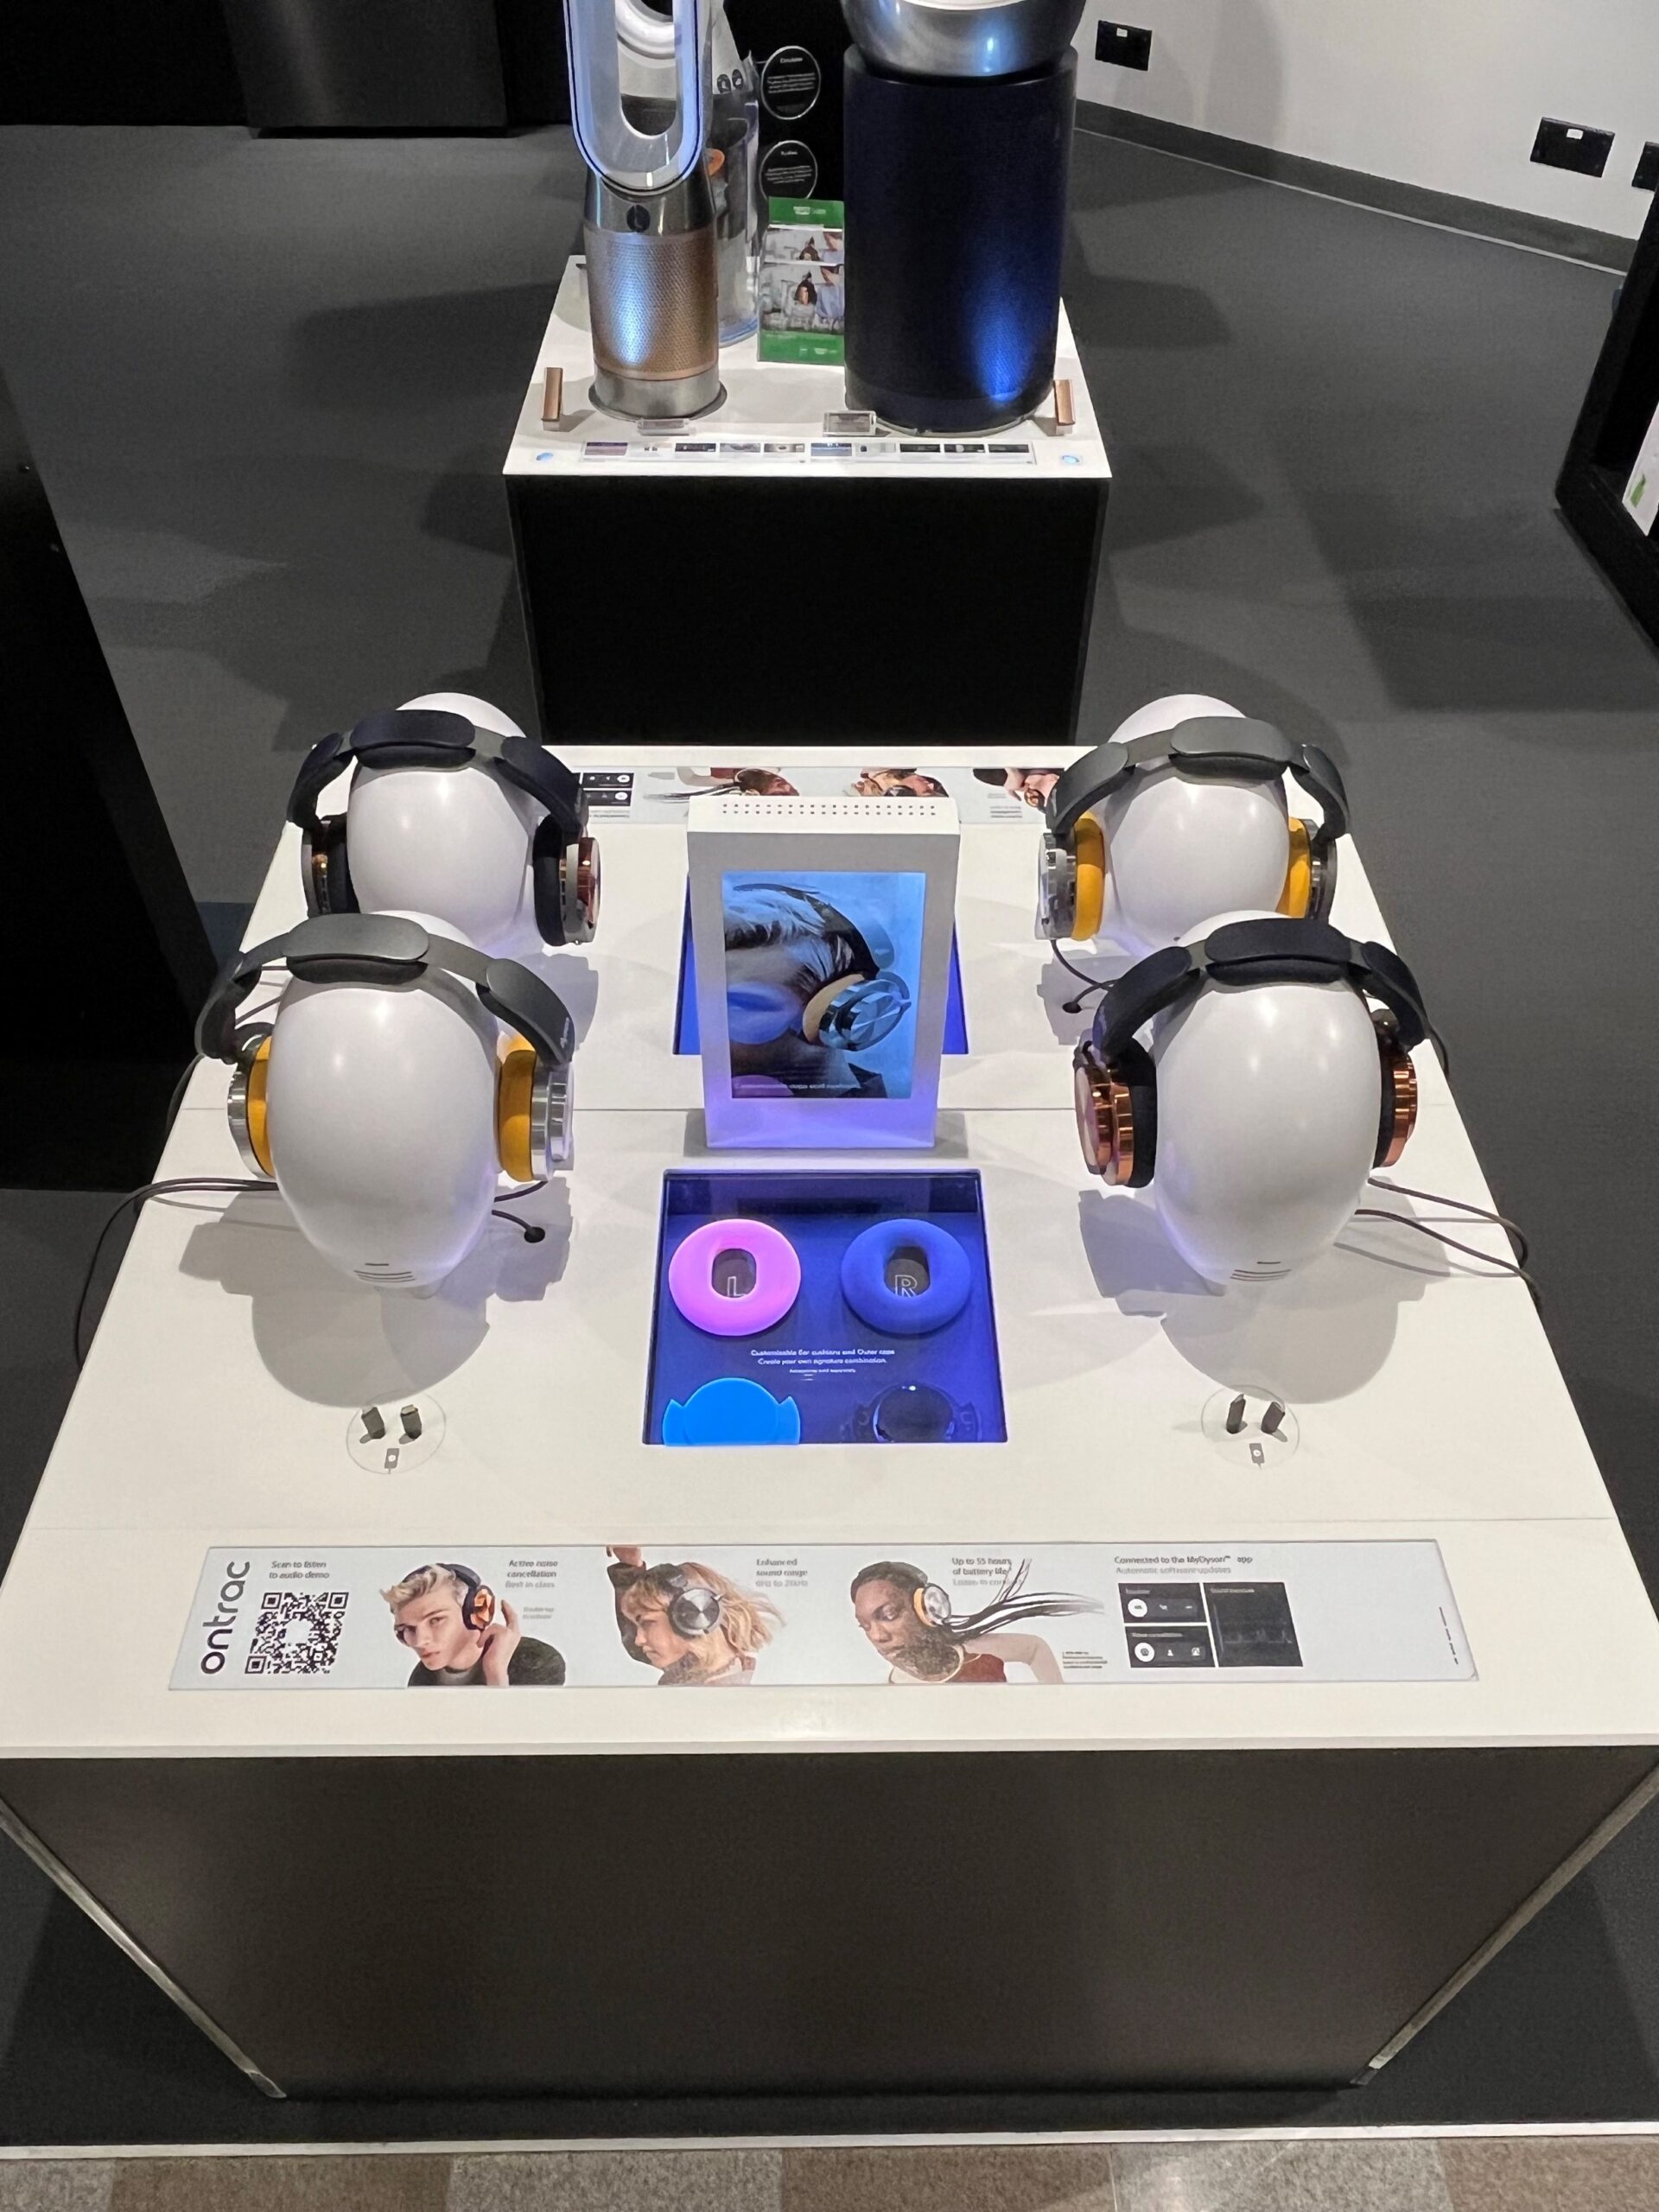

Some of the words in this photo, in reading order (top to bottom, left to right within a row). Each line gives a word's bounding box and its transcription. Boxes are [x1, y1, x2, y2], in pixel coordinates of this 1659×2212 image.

[894, 1274, 918, 1297] R
[951, 1557, 965, 1566] Up
[963, 1567, 994, 1576] battery
[200, 1561, 251, 1675] ontrac
